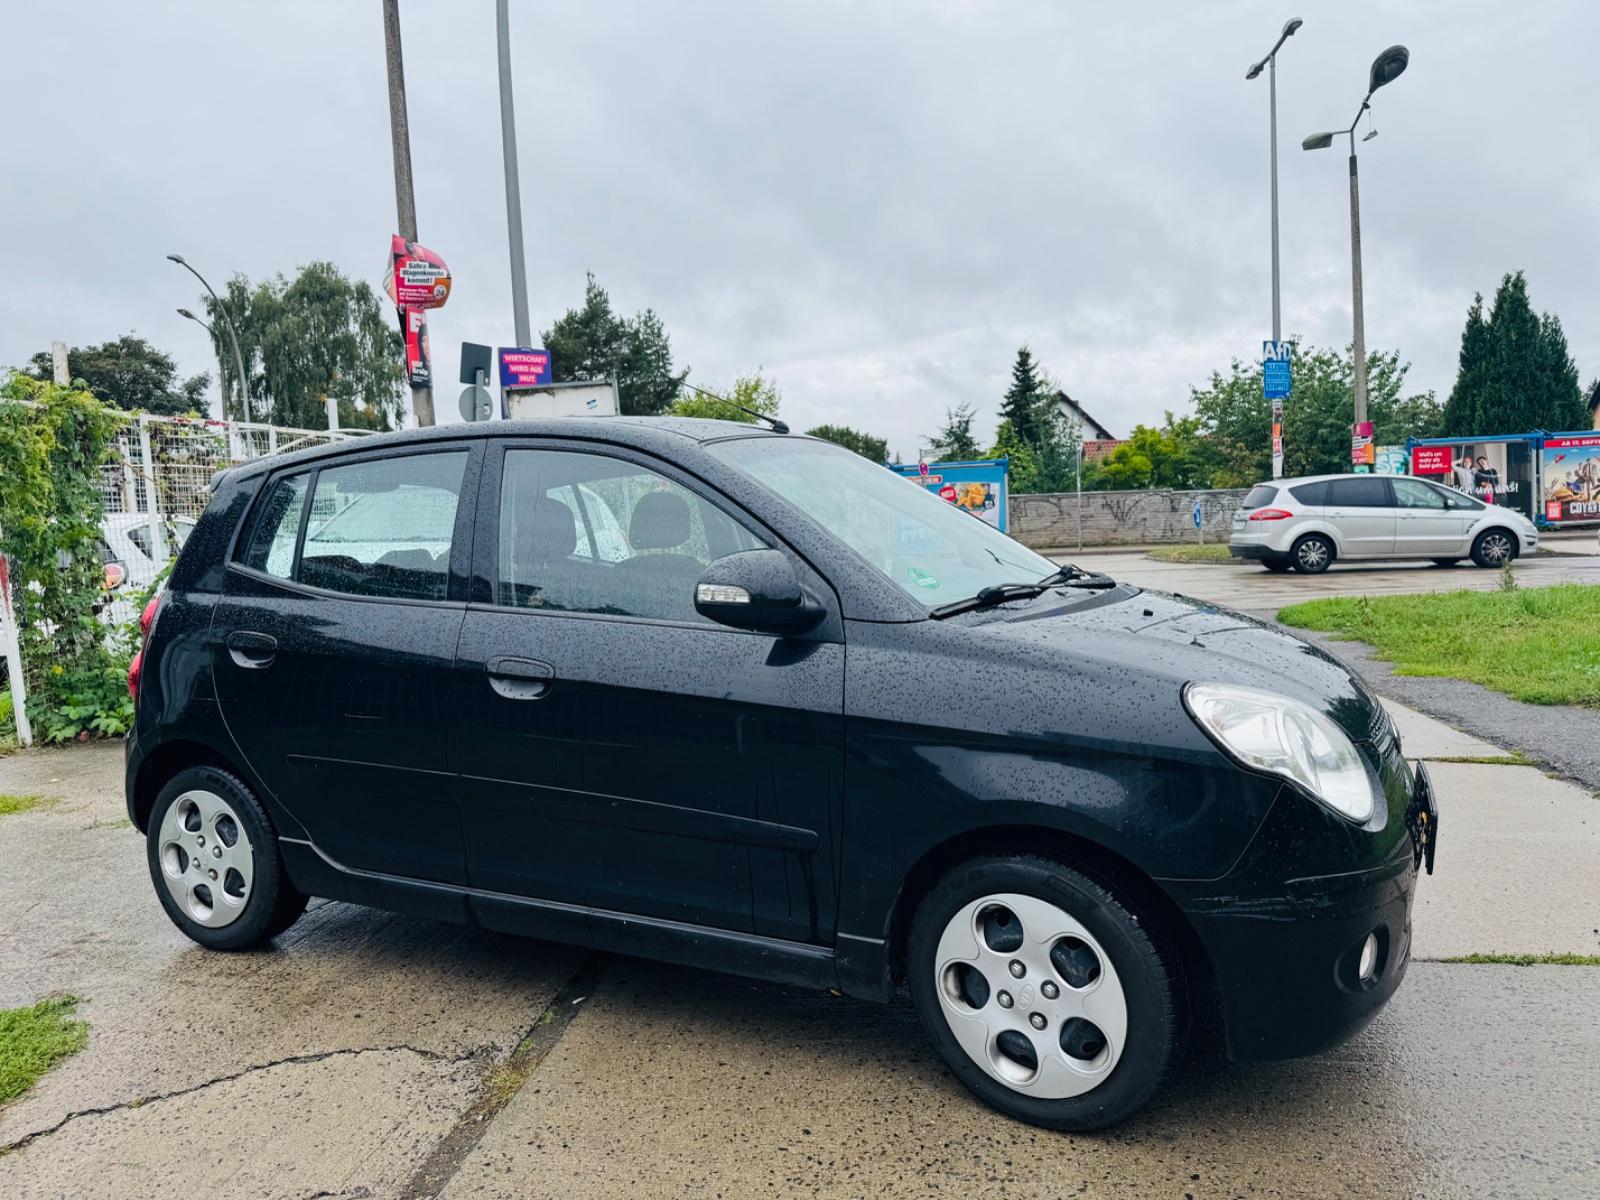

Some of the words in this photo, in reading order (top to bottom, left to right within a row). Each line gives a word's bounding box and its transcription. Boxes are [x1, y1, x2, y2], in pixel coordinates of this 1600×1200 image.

[1264, 342, 1291, 361] AfD
[504, 354, 546, 363] WIRTSCHAFT
[530, 365, 544, 373] AUS
